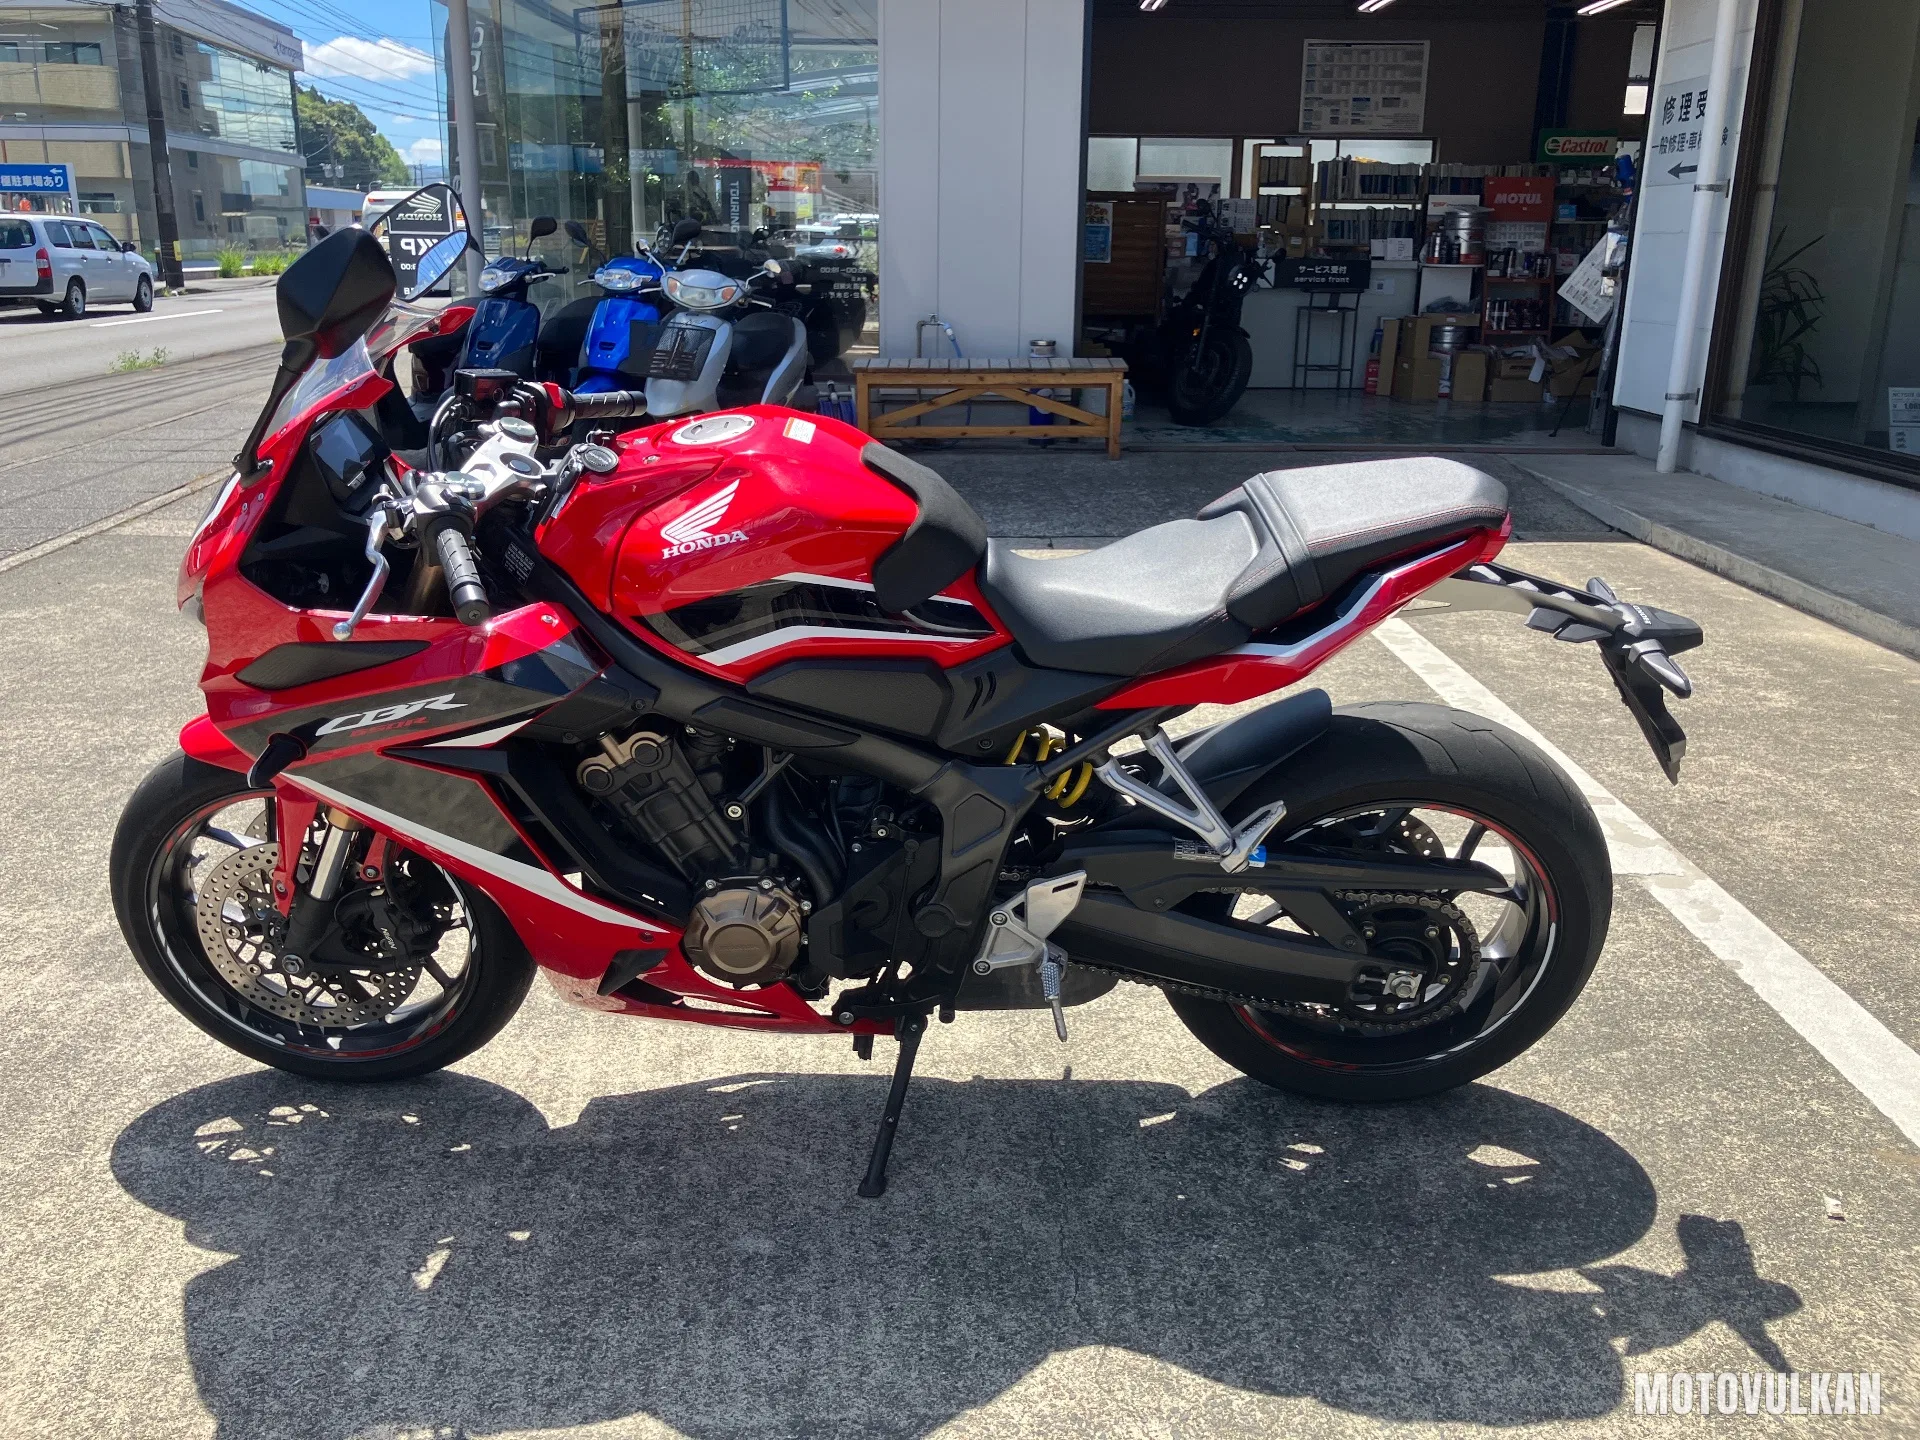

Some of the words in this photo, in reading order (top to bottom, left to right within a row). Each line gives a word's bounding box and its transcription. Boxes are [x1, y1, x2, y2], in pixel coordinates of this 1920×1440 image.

[1561, 139, 1609, 153] Castrol
[729, 181, 740, 233] TOURING
[1494, 193, 1543, 205] MOTUL
[1298, 266, 1347, 274] サービス受付
[662, 530, 750, 560] HONDA
[315, 693, 469, 737] CBR
